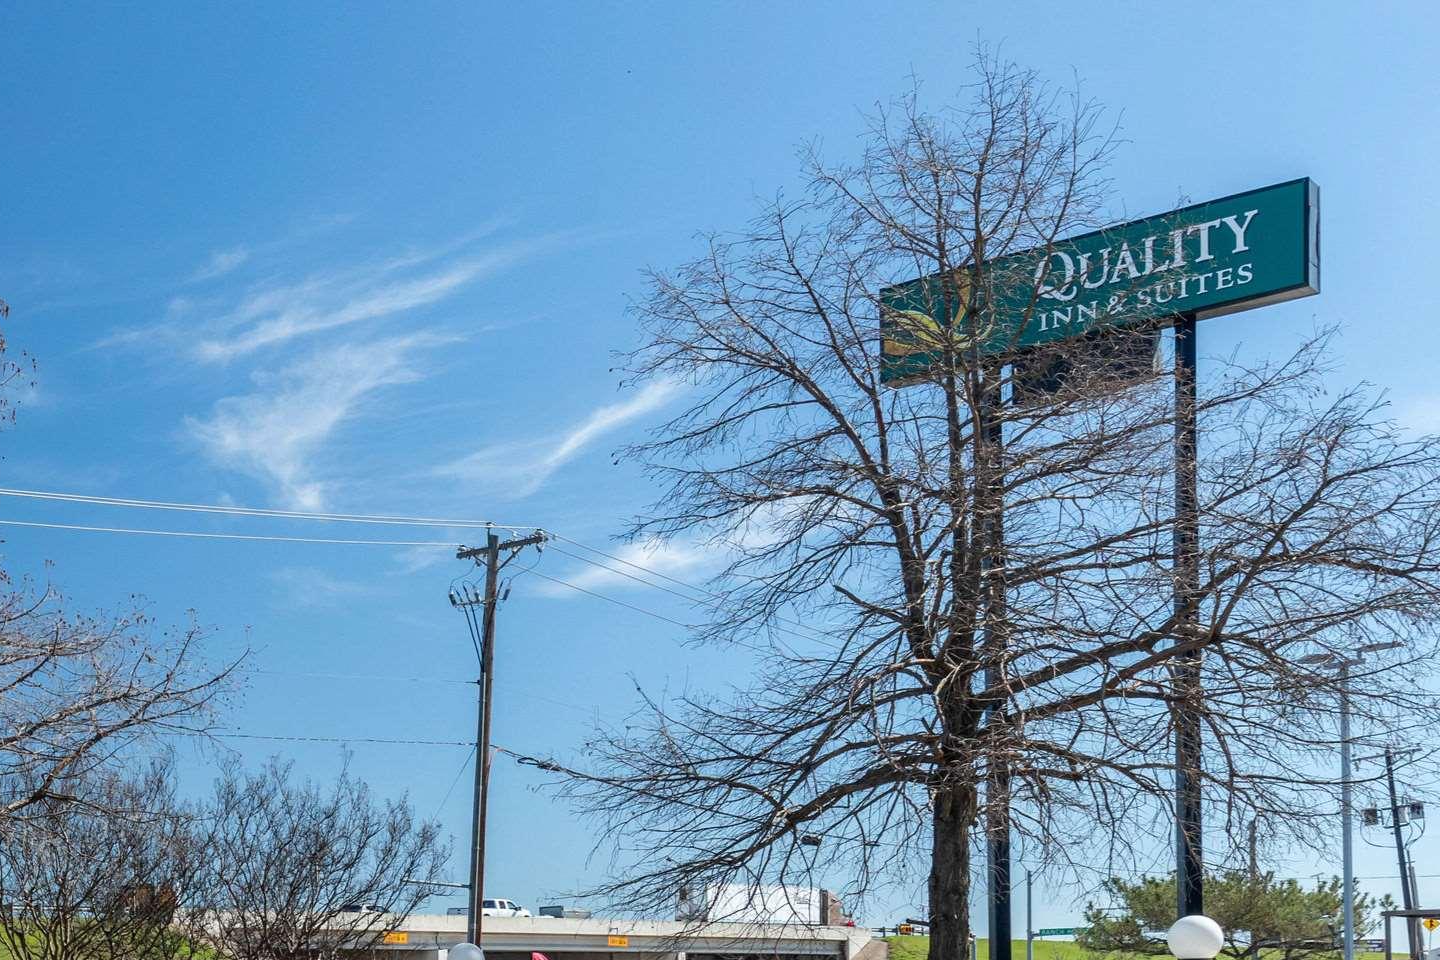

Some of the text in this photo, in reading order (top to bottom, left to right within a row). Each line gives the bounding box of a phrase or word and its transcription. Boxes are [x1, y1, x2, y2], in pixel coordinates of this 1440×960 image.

[1034, 209, 1259, 301] QUALITY
[1038, 263, 1254, 332] INN & SUITES
